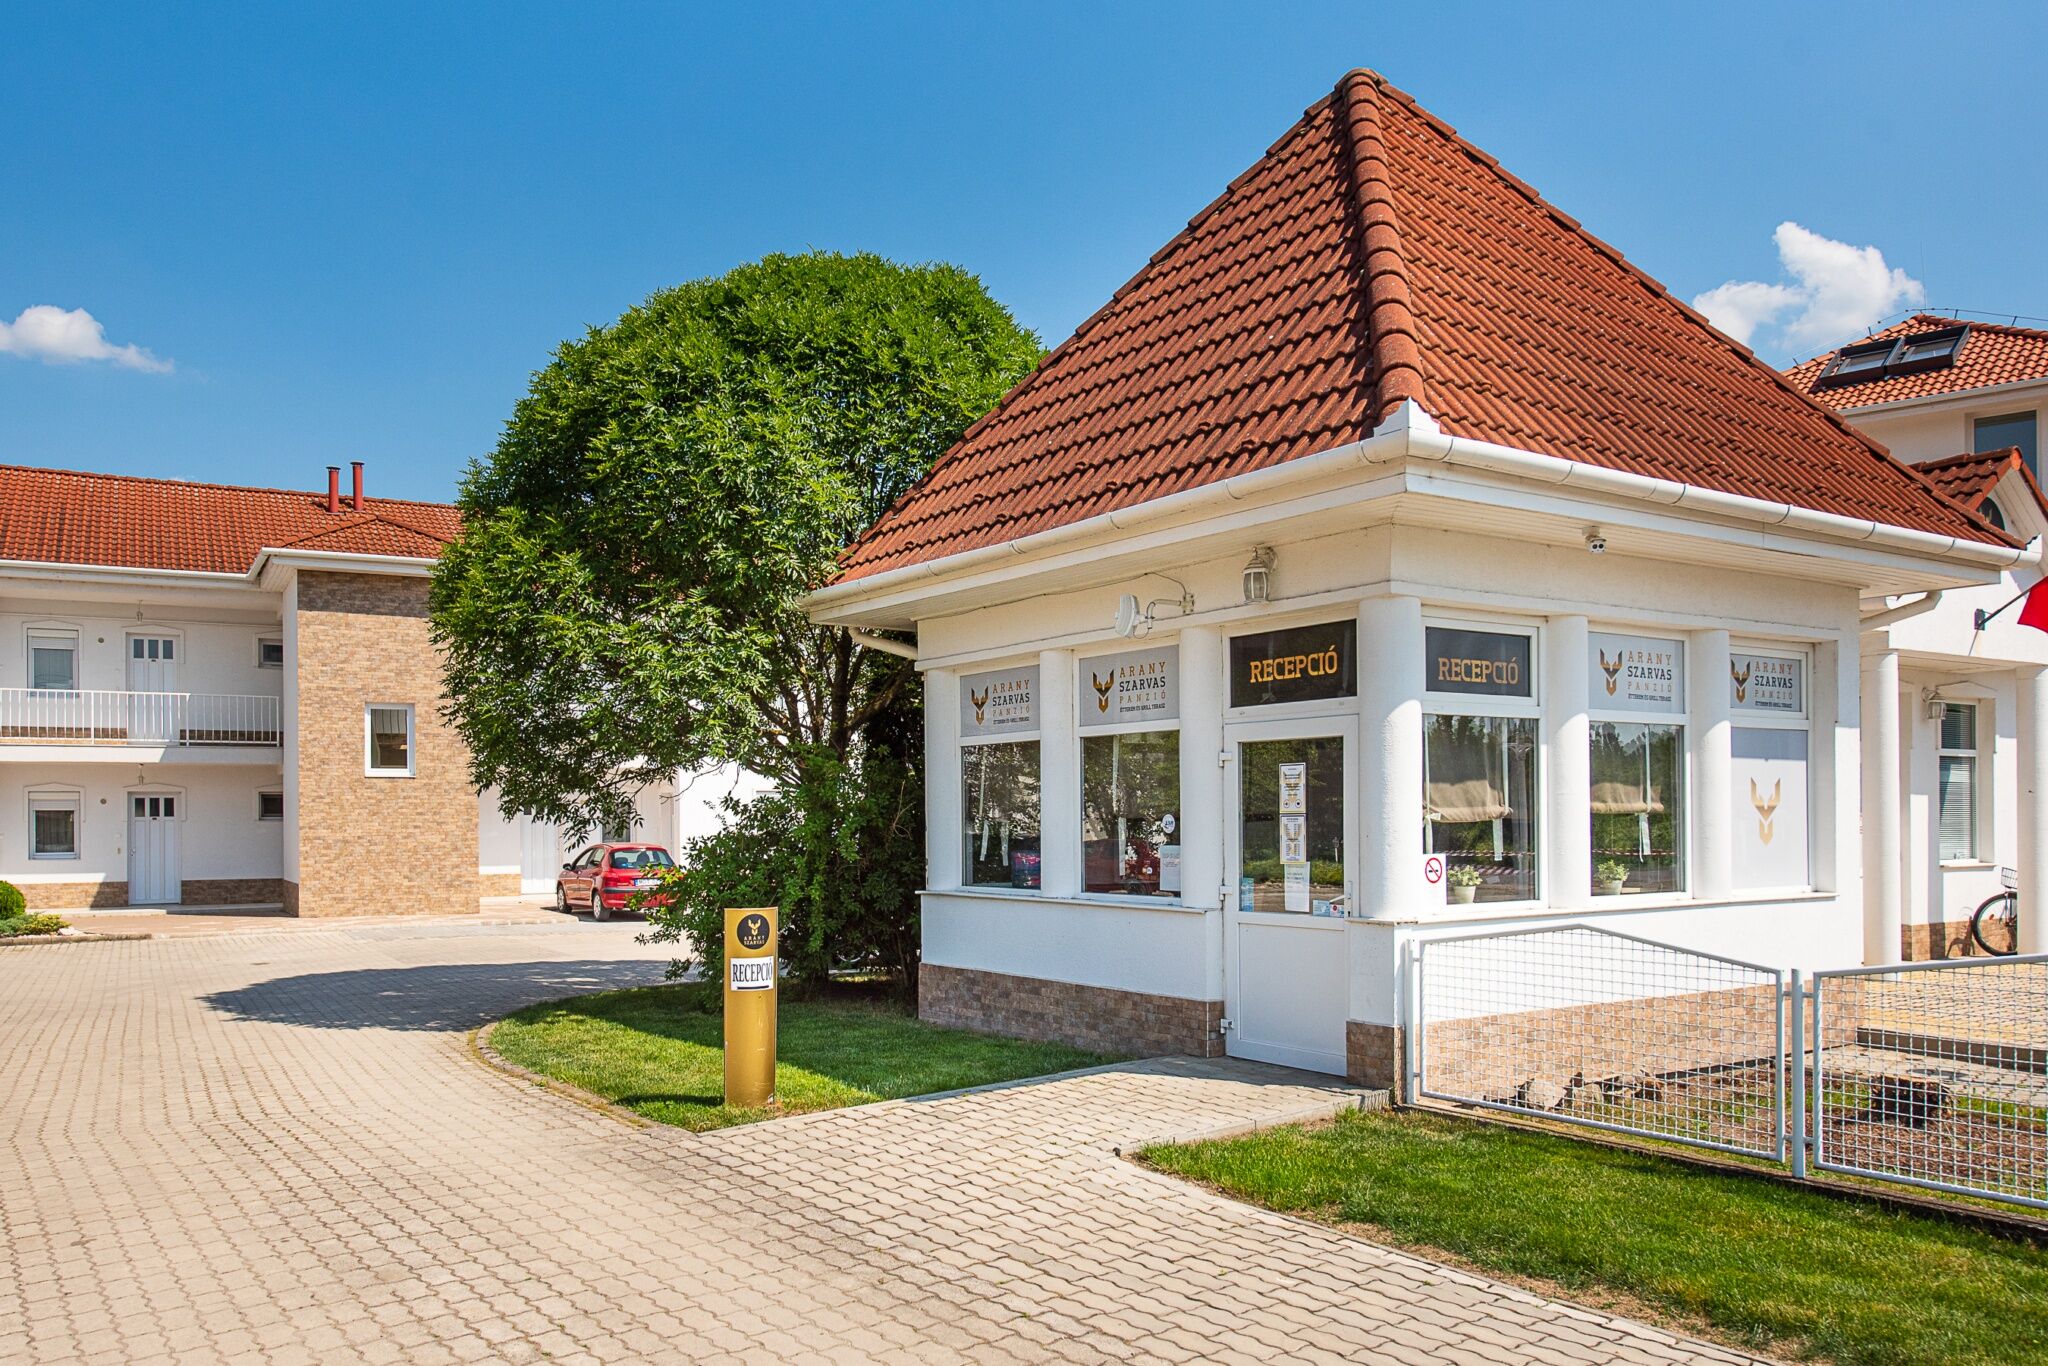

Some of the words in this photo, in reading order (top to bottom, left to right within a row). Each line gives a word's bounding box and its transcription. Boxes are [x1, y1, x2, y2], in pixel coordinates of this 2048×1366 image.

[1249, 644, 1338, 683] RECEPCIÓ
[1627, 650, 1672, 666] ARANY
[1119, 661, 1166, 678] ARANY
[1438, 656, 1519, 684] RECEPCIÓ
[1627, 666, 1672, 681] SZARVAS
[1754, 660, 1793, 675] ARANY
[992, 679, 1030, 694] ARANY
[1119, 676, 1166, 693] SZARVAS
[1627, 681, 1672, 693] PANZIÓ
[1754, 675, 1793, 689] SZARVAS
[992, 692, 1030, 707] SZARVAS
[1119, 689, 1166, 704] PANZIÓ
[1754, 689, 1793, 701] PANZIÓ
[992, 704, 1030, 717] PANZIÓ
[732, 957, 773, 983] RECEPCIÓ
